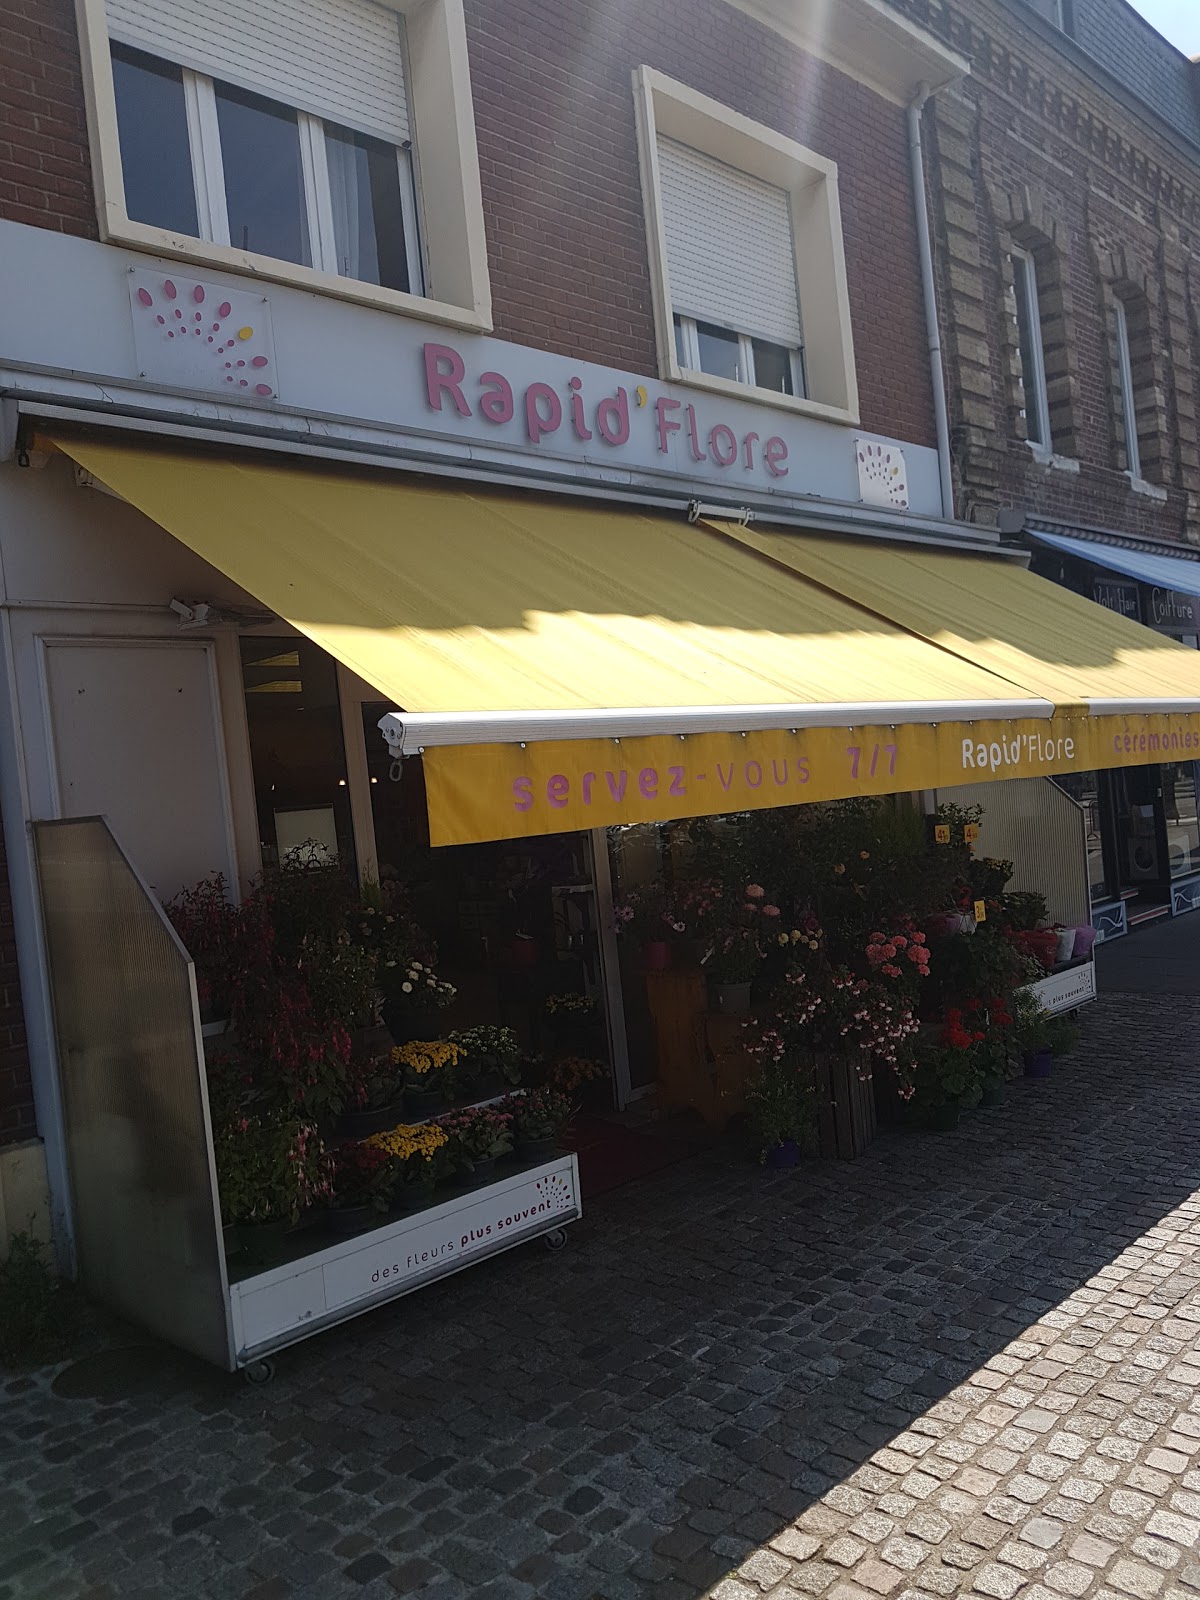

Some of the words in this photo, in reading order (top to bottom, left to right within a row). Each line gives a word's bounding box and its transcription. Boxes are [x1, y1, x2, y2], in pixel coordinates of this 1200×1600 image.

[423, 343, 789, 477] Rapid'Flore
[1152, 587, 1193, 624] Coiffure
[961, 733, 1076, 773] Rapid'Flore
[1113, 726, 1200, 753] cérémonies
[512, 757, 811, 812] servez-vous
[846, 743, 899, 779] 7/7
[371, 1263, 399, 1283] des
[406, 1240, 454, 1268] fleurs
[460, 1224, 492, 1247] plus
[497, 1199, 552, 1230] souvent
